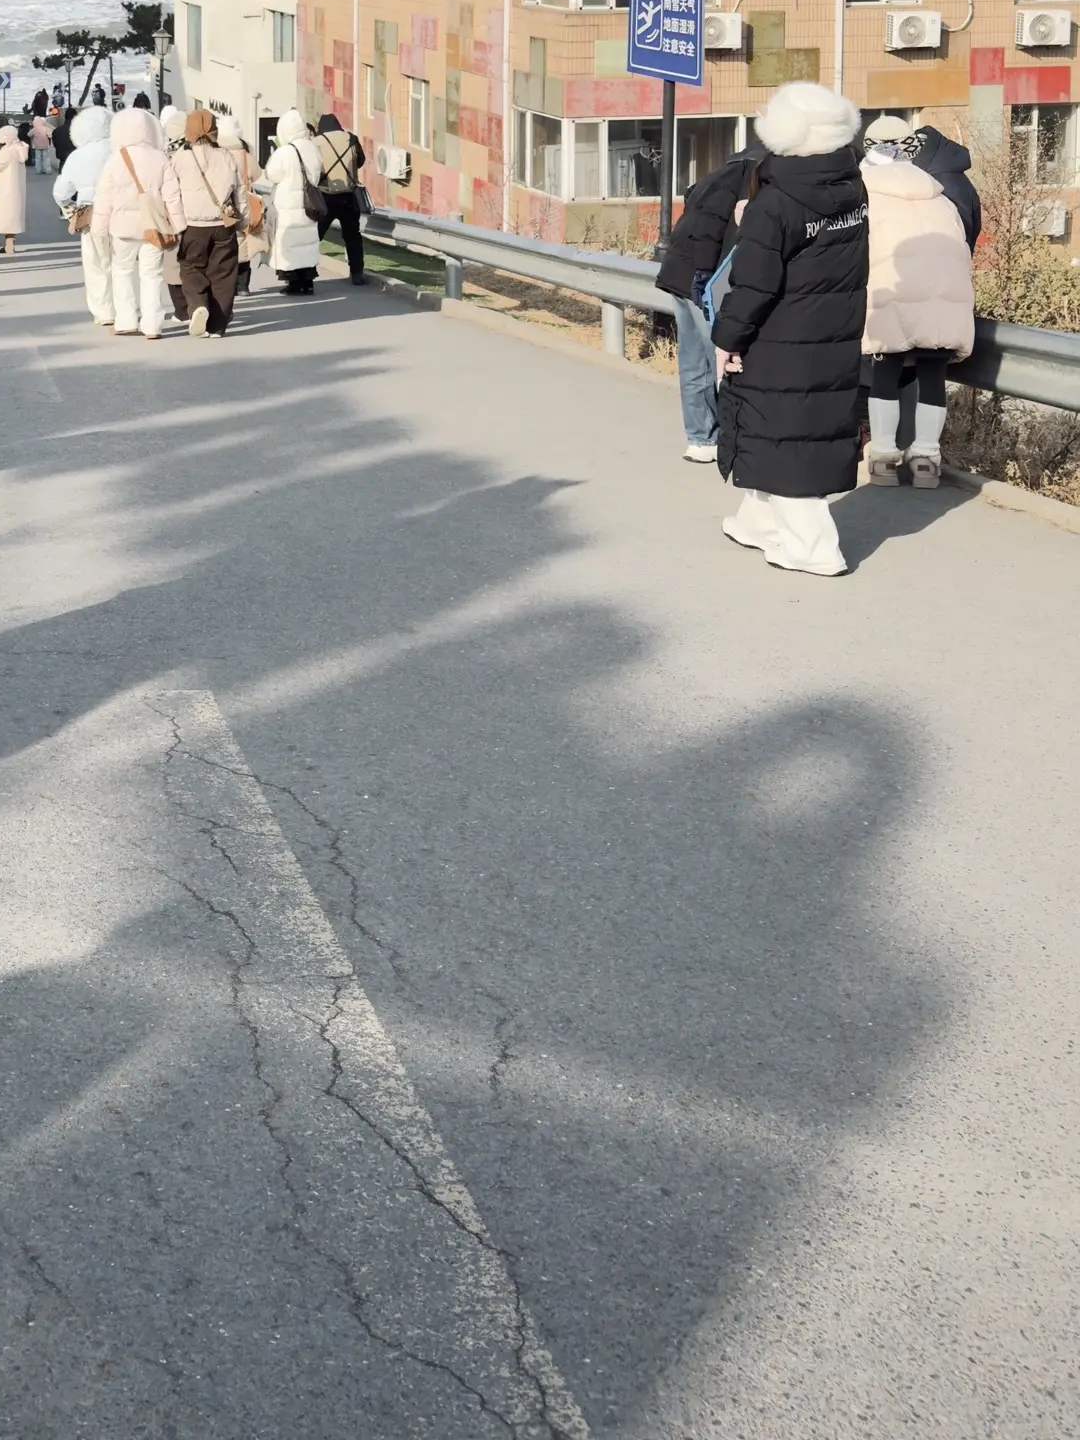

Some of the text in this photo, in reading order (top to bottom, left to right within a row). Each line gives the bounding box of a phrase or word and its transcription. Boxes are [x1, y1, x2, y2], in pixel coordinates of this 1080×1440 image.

[663, 17, 696, 35] 地面湿滑
[662, 37, 696, 57] 注意安全
